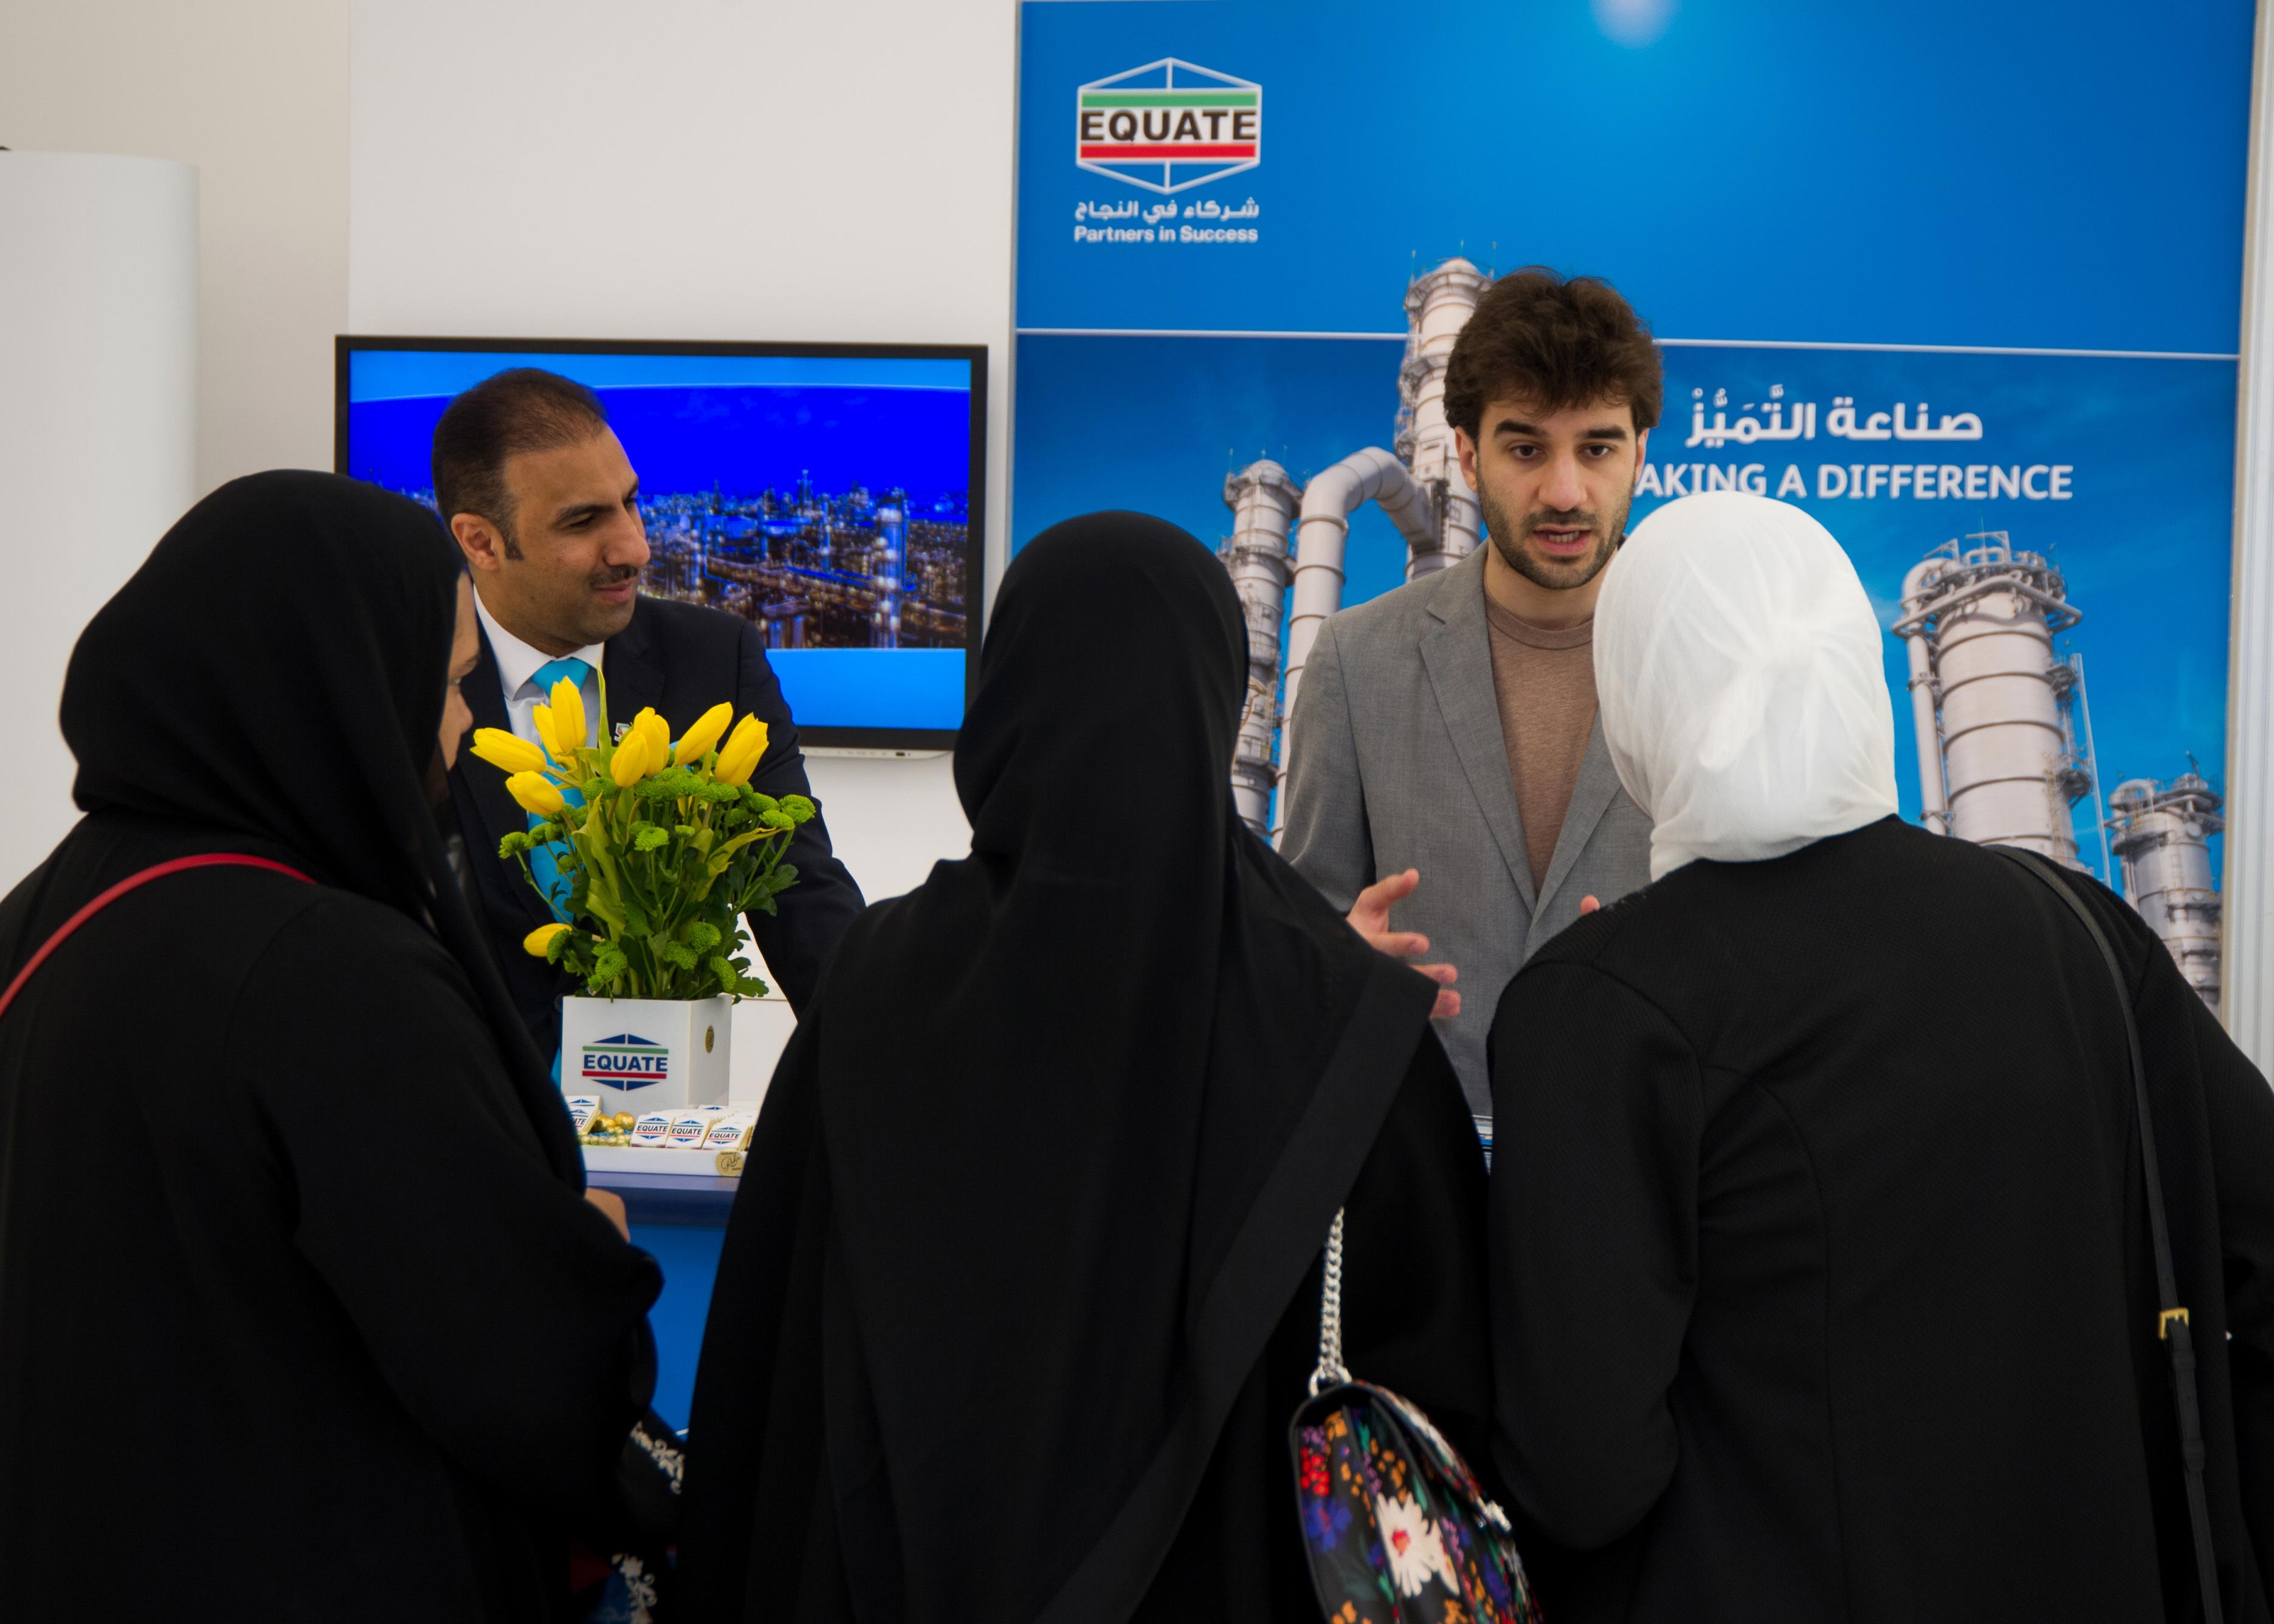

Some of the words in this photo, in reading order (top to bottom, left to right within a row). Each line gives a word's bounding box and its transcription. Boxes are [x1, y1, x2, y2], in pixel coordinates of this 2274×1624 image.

[1080, 109, 1257, 143] EQUATE
[1074, 200, 1139, 221] النجاح
[1142, 199, 1178, 225] في
[1183, 196, 1260, 222] شركاء
[1073, 225, 1154, 243] Partners
[1159, 225, 1176, 243] in
[1180, 224, 1259, 243] Success
[1825, 396, 1983, 441] صناعة
[1635, 463, 1768, 498] AKING
[1776, 464, 1807, 498] A
[1817, 464, 2074, 500] DIFFERENCE
[584, 1054, 668, 1072] EQUATE
